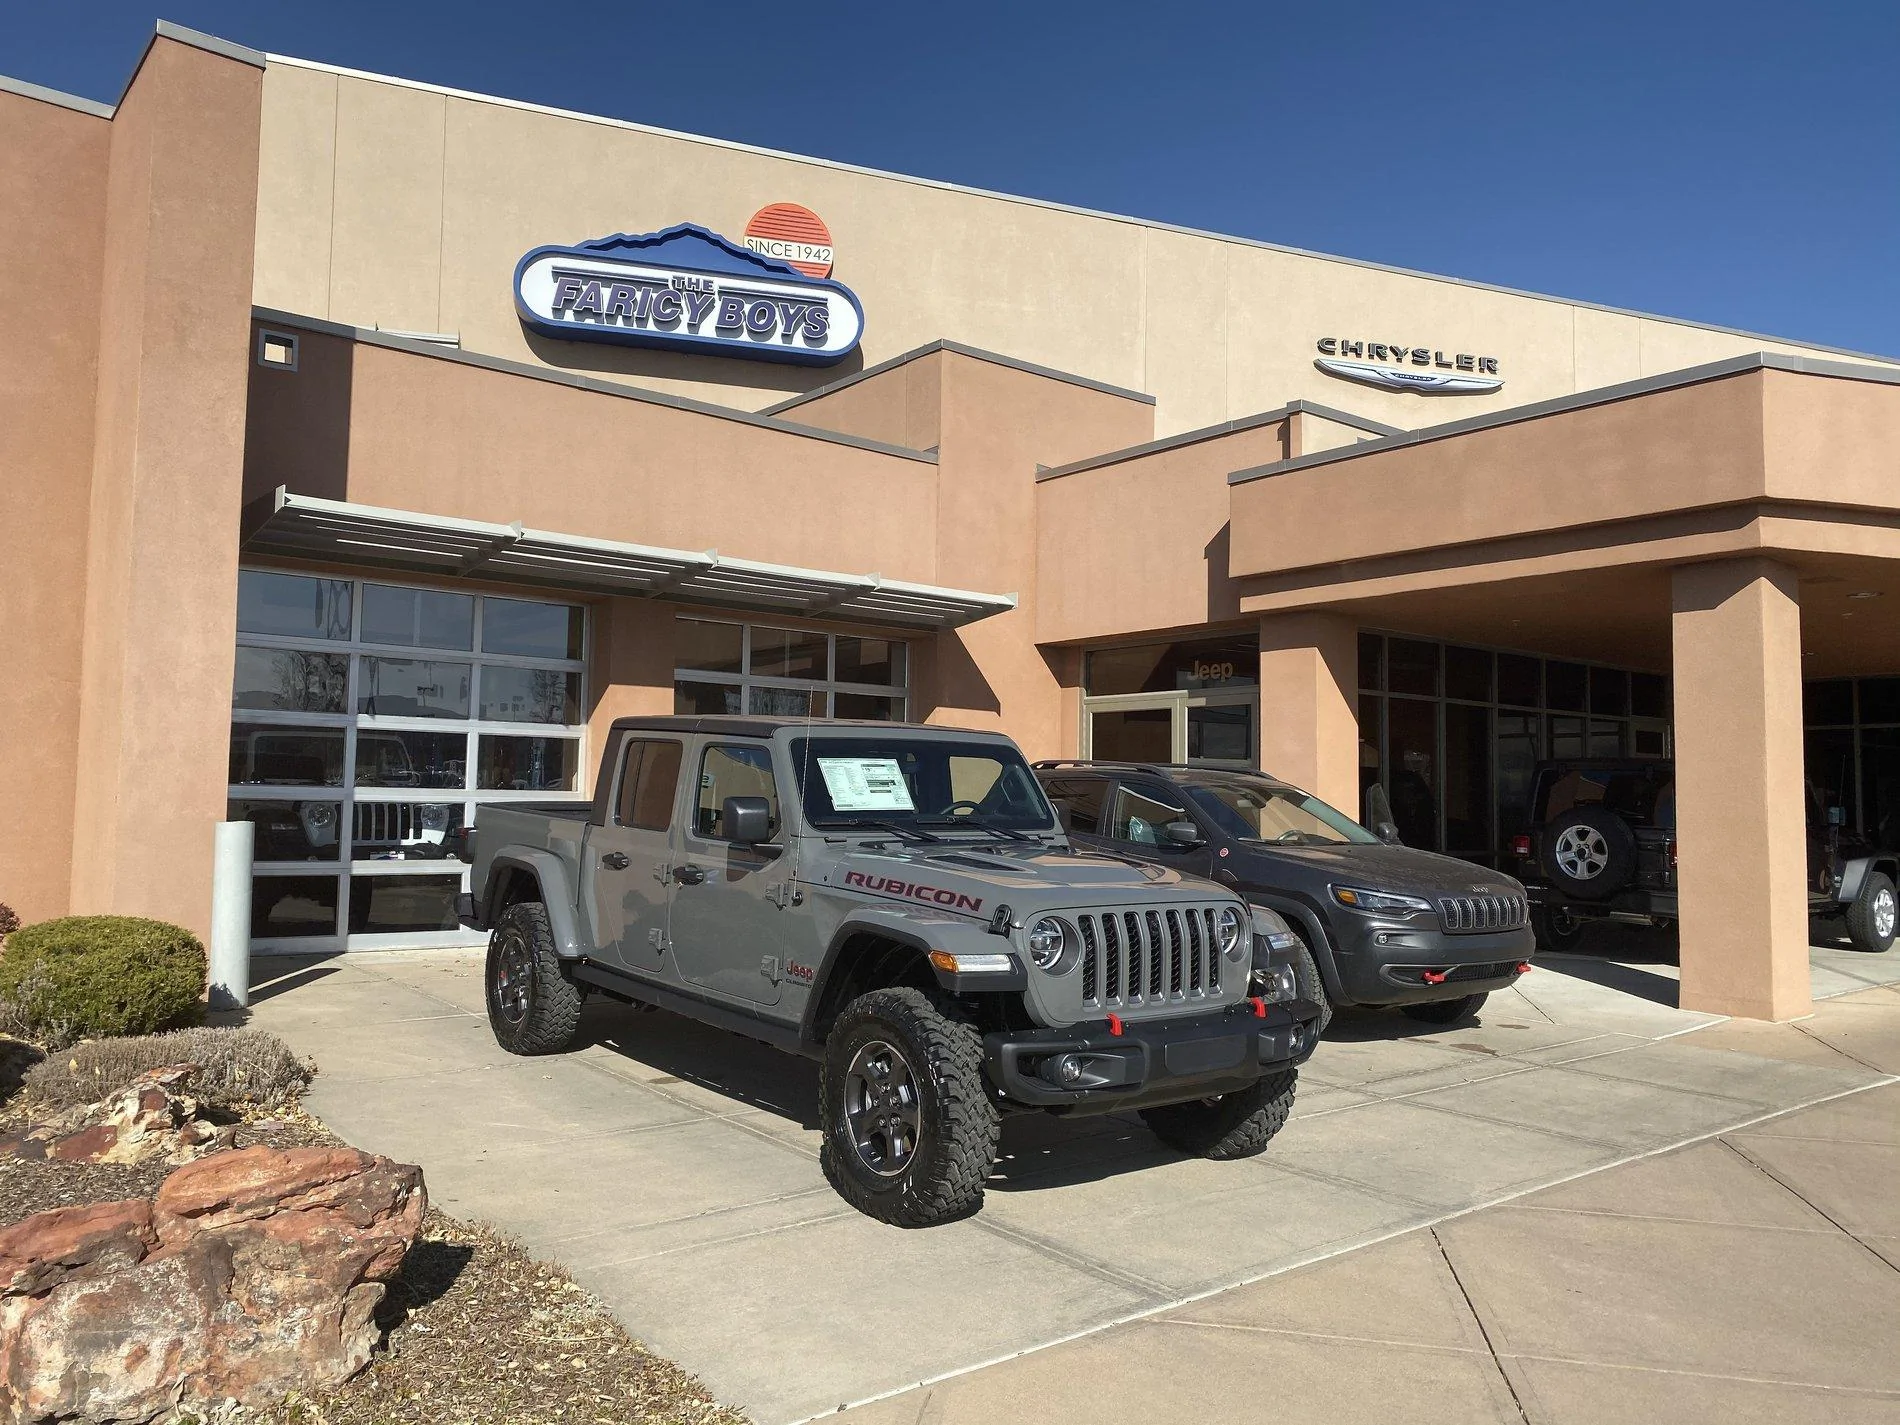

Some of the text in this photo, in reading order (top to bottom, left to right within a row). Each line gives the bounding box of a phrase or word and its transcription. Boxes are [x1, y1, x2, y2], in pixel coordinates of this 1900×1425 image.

[747, 239, 831, 261] SINCE 1942
[672, 275, 715, 293] THE
[551, 276, 830, 339] FARICY BOYS
[1317, 337, 1499, 373] CHRYSLER
[1187, 659, 1233, 682] Jeep
[844, 871, 983, 912] RUBICON
